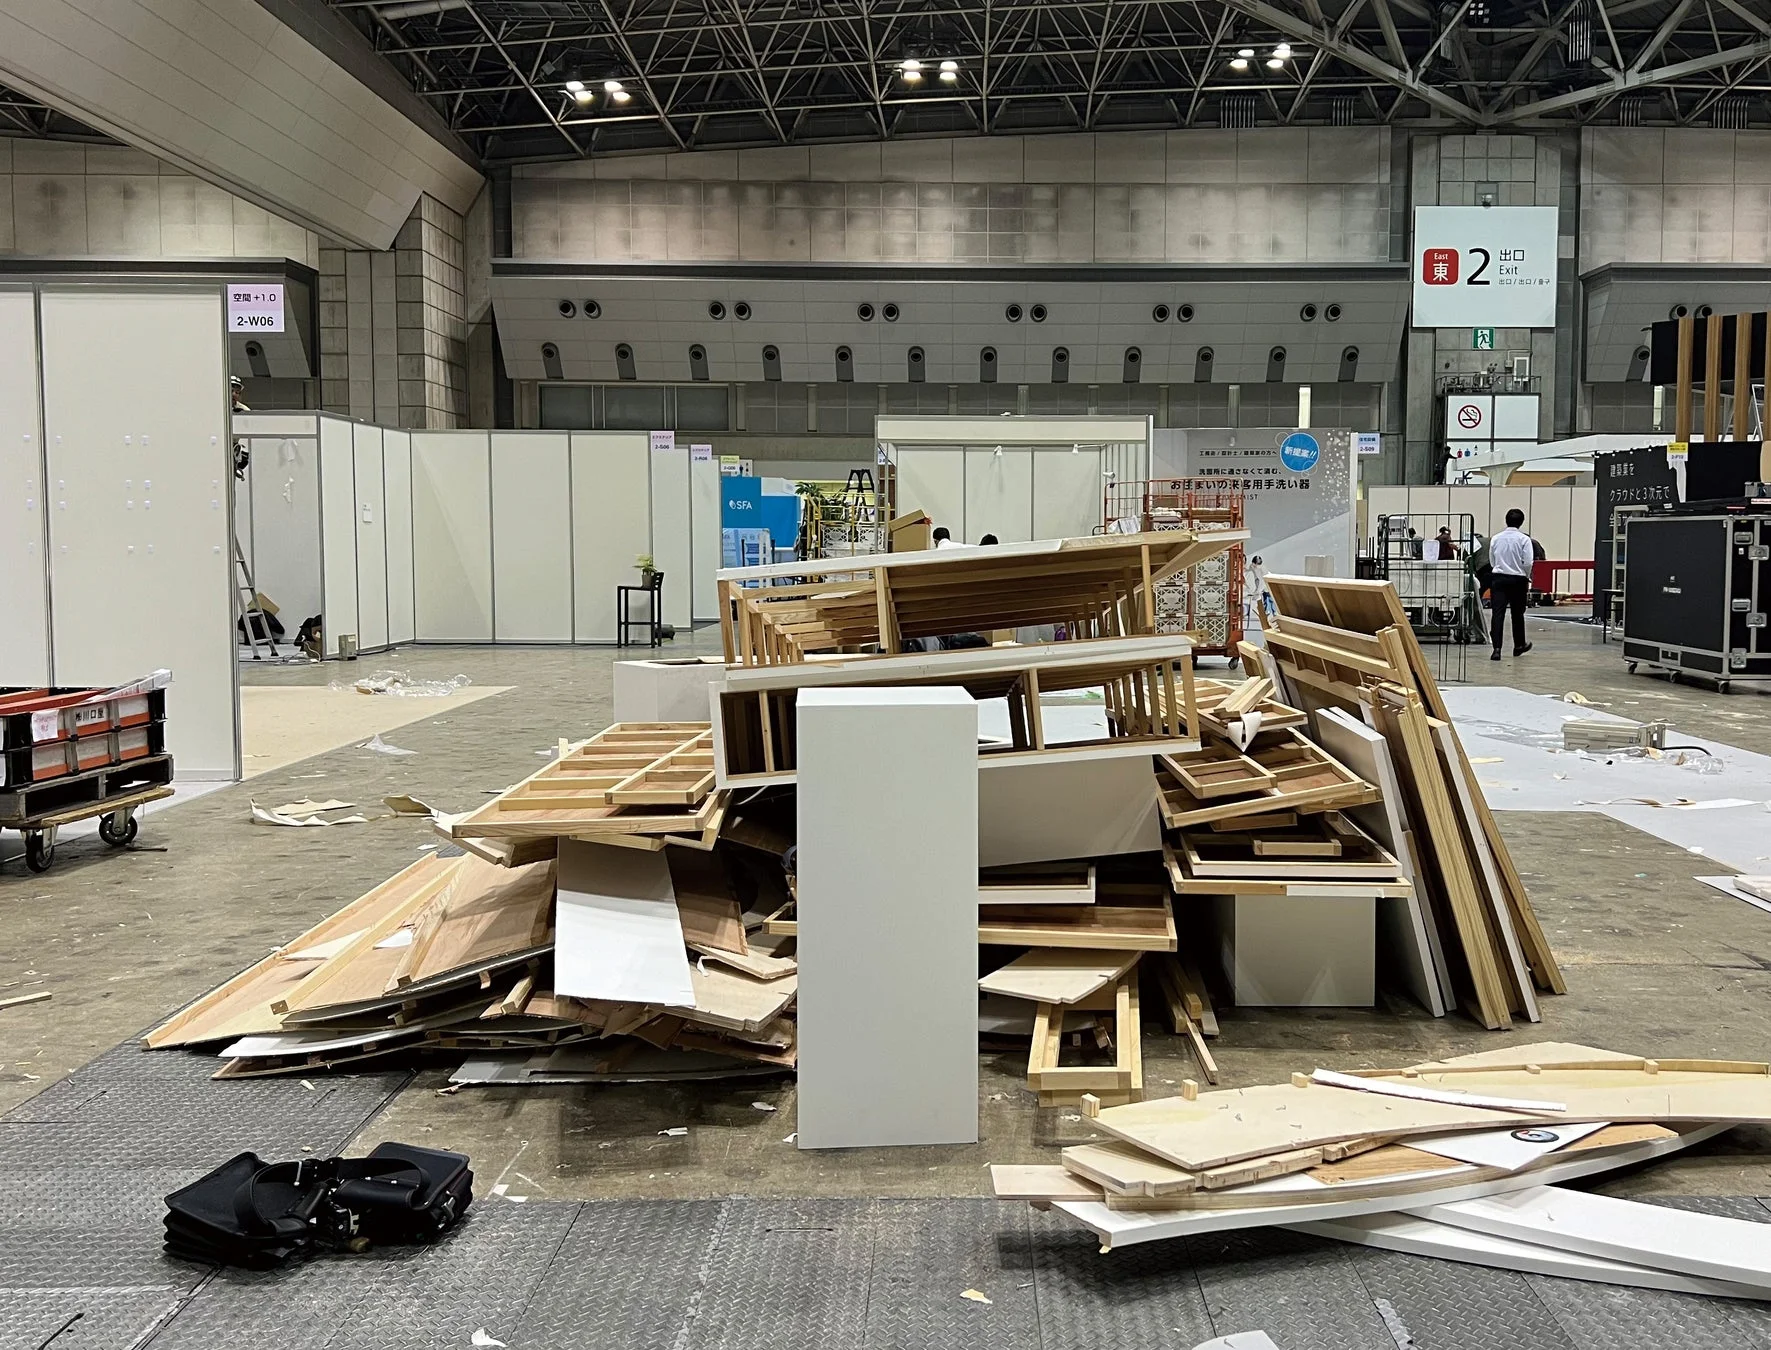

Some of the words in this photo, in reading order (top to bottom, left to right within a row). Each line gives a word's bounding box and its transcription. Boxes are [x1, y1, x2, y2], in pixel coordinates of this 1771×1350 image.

[1434, 252, 1448, 260] East
[1499, 248, 1525, 262] 出口
[1432, 261, 1449, 282] 東
[1466, 247, 1491, 286] 2
[1499, 265, 1518, 275] Exit
[237, 316, 274, 326] 2-W06
[736, 500, 752, 510] SFA
